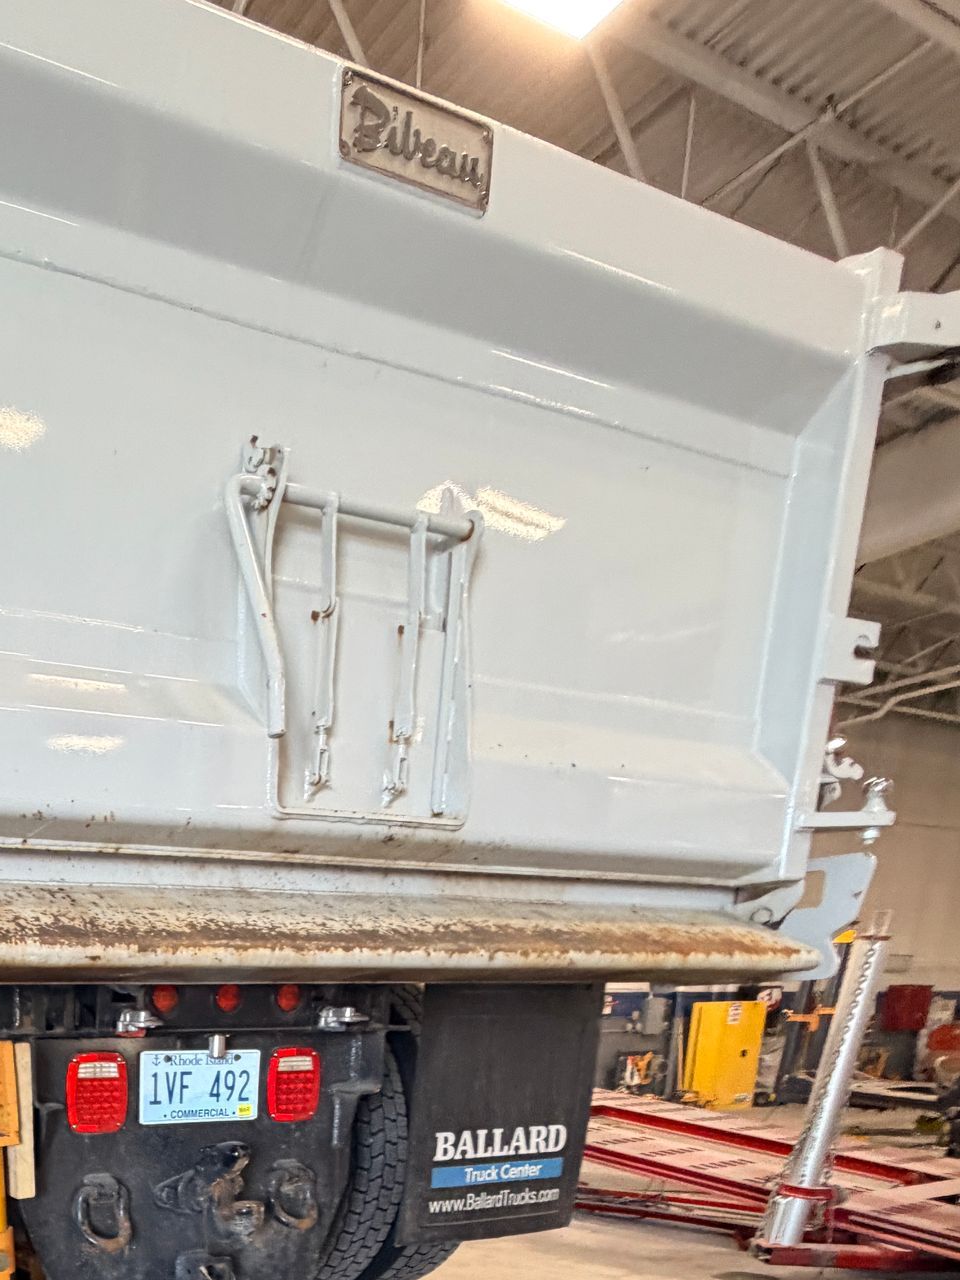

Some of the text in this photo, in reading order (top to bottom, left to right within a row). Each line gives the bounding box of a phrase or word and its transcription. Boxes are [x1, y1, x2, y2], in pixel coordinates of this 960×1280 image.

[350, 84, 483, 188] Bibeau
[170, 1054, 203, 1066] Rhode
[149, 1070, 250, 1105] 1VF 492
[170, 1108, 230, 1119] COMMERCIAL
[433, 1124, 568, 1162] BALLARD
[464, 1163, 543, 1183] Truck Center
[428, 1187, 560, 1214] www.BallardTrucks.com
